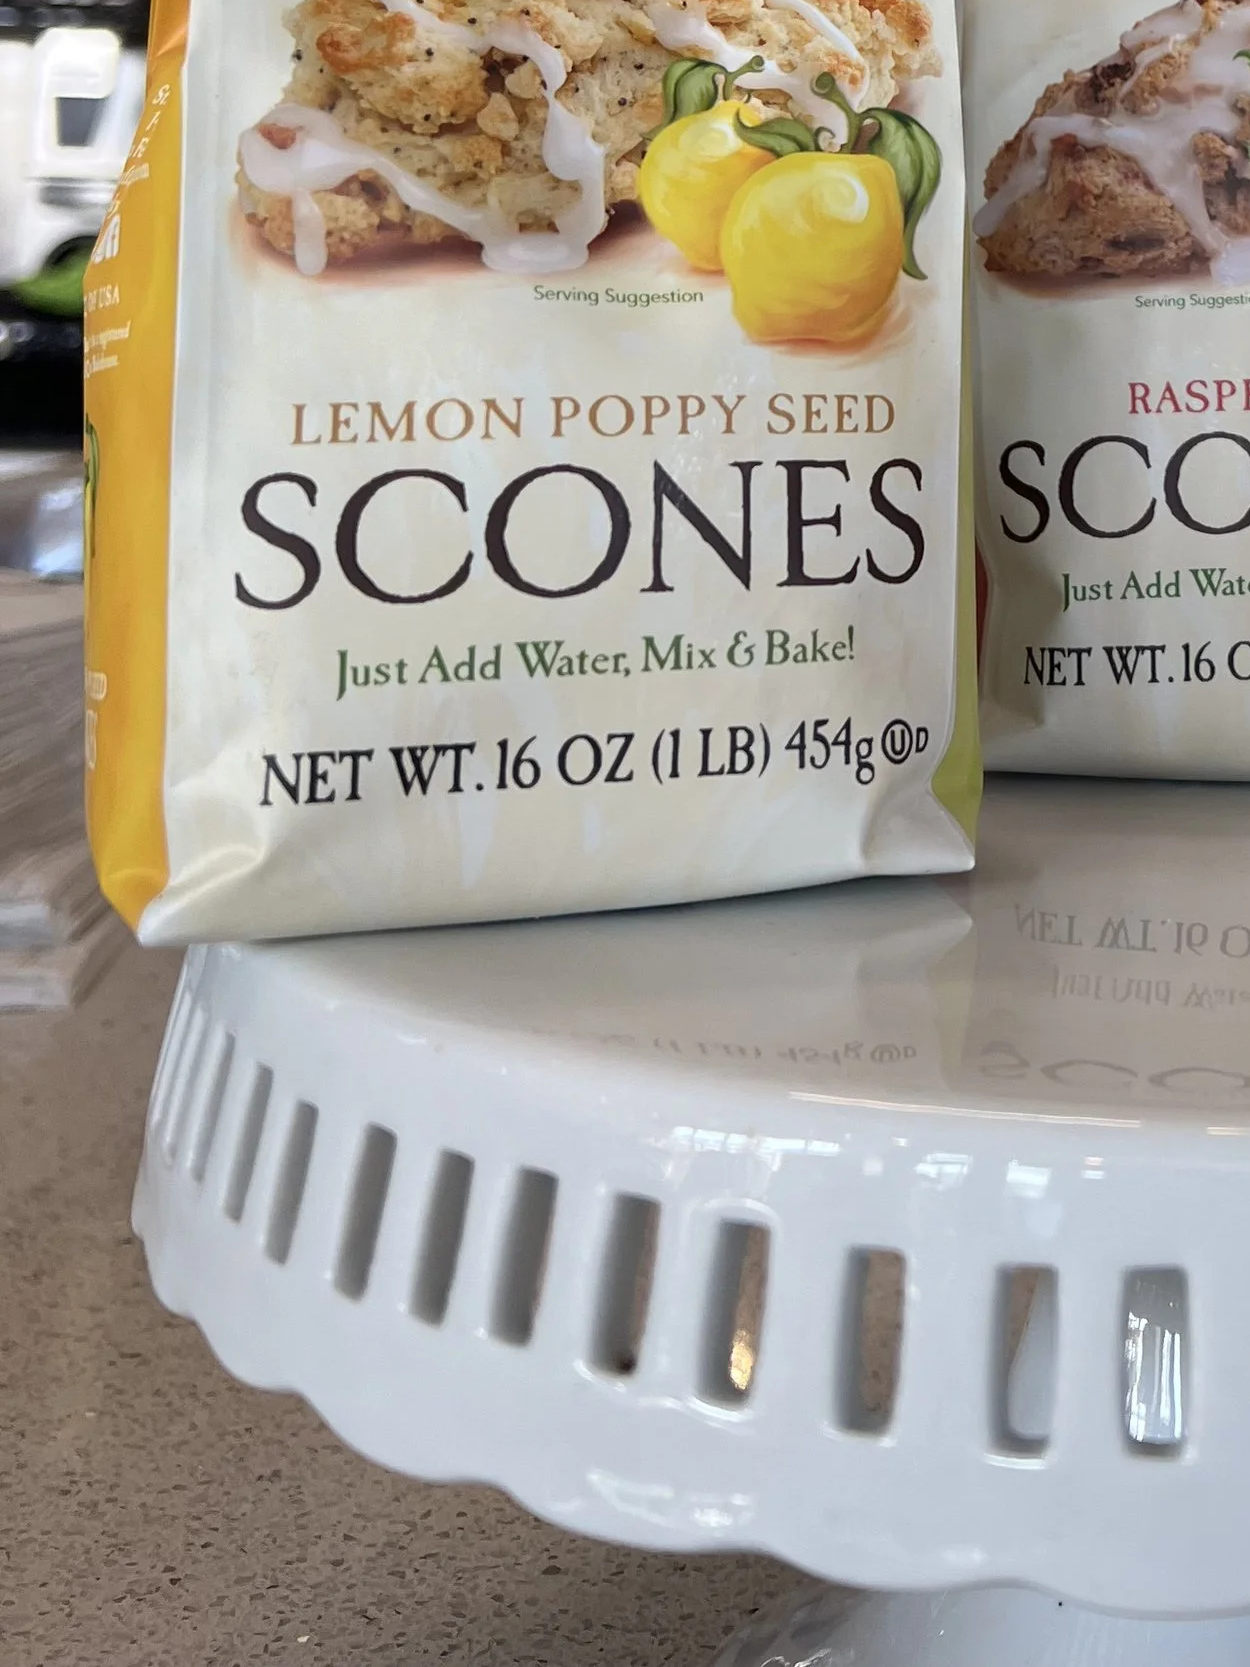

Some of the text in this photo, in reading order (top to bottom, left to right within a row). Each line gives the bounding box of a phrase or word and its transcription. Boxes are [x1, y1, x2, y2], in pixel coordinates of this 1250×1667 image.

[533, 285, 705, 307] Serving Suggestion
[1134, 294, 1187, 310] Serving
[290, 392, 896, 447] LEMON POPPY SEED
[234, 458, 927, 610] SCONES
[1062, 573, 1114, 611] Just
[1120, 566, 1182, 600] Add
[335, 625, 856, 701] Just Add Water, Mix & Bake!
[1024, 646, 1092, 686] NET
[261, 749, 373, 807] NET
[557, 731, 635, 787] OZ
[651, 727, 682, 783] (1
[696, 721, 772, 779] LB)
[784, 716, 875, 787] 454g
